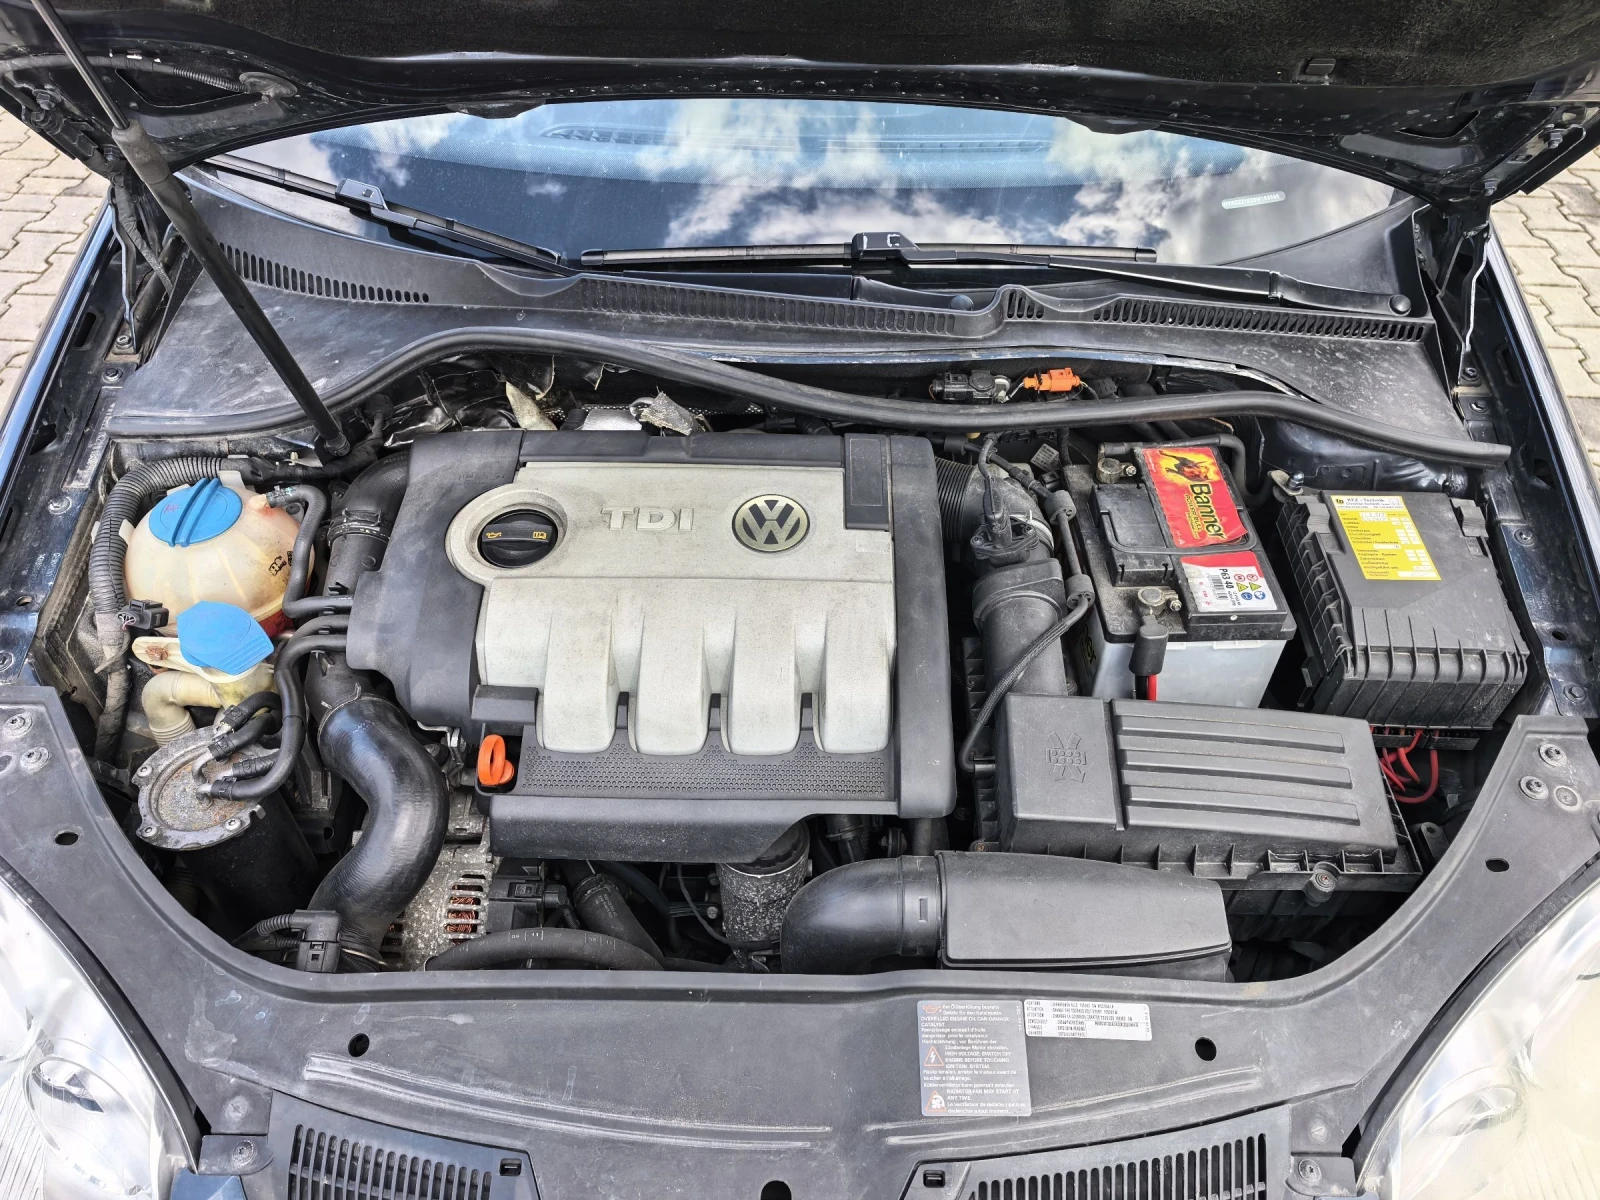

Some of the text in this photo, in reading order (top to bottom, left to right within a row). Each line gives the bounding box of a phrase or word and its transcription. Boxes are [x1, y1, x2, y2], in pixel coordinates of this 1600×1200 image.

[600, 506, 694, 531] TDI
[1189, 482, 1226, 540] Banner
[1219, 568, 1231, 580] P63
[1225, 581, 1235, 589] 40
